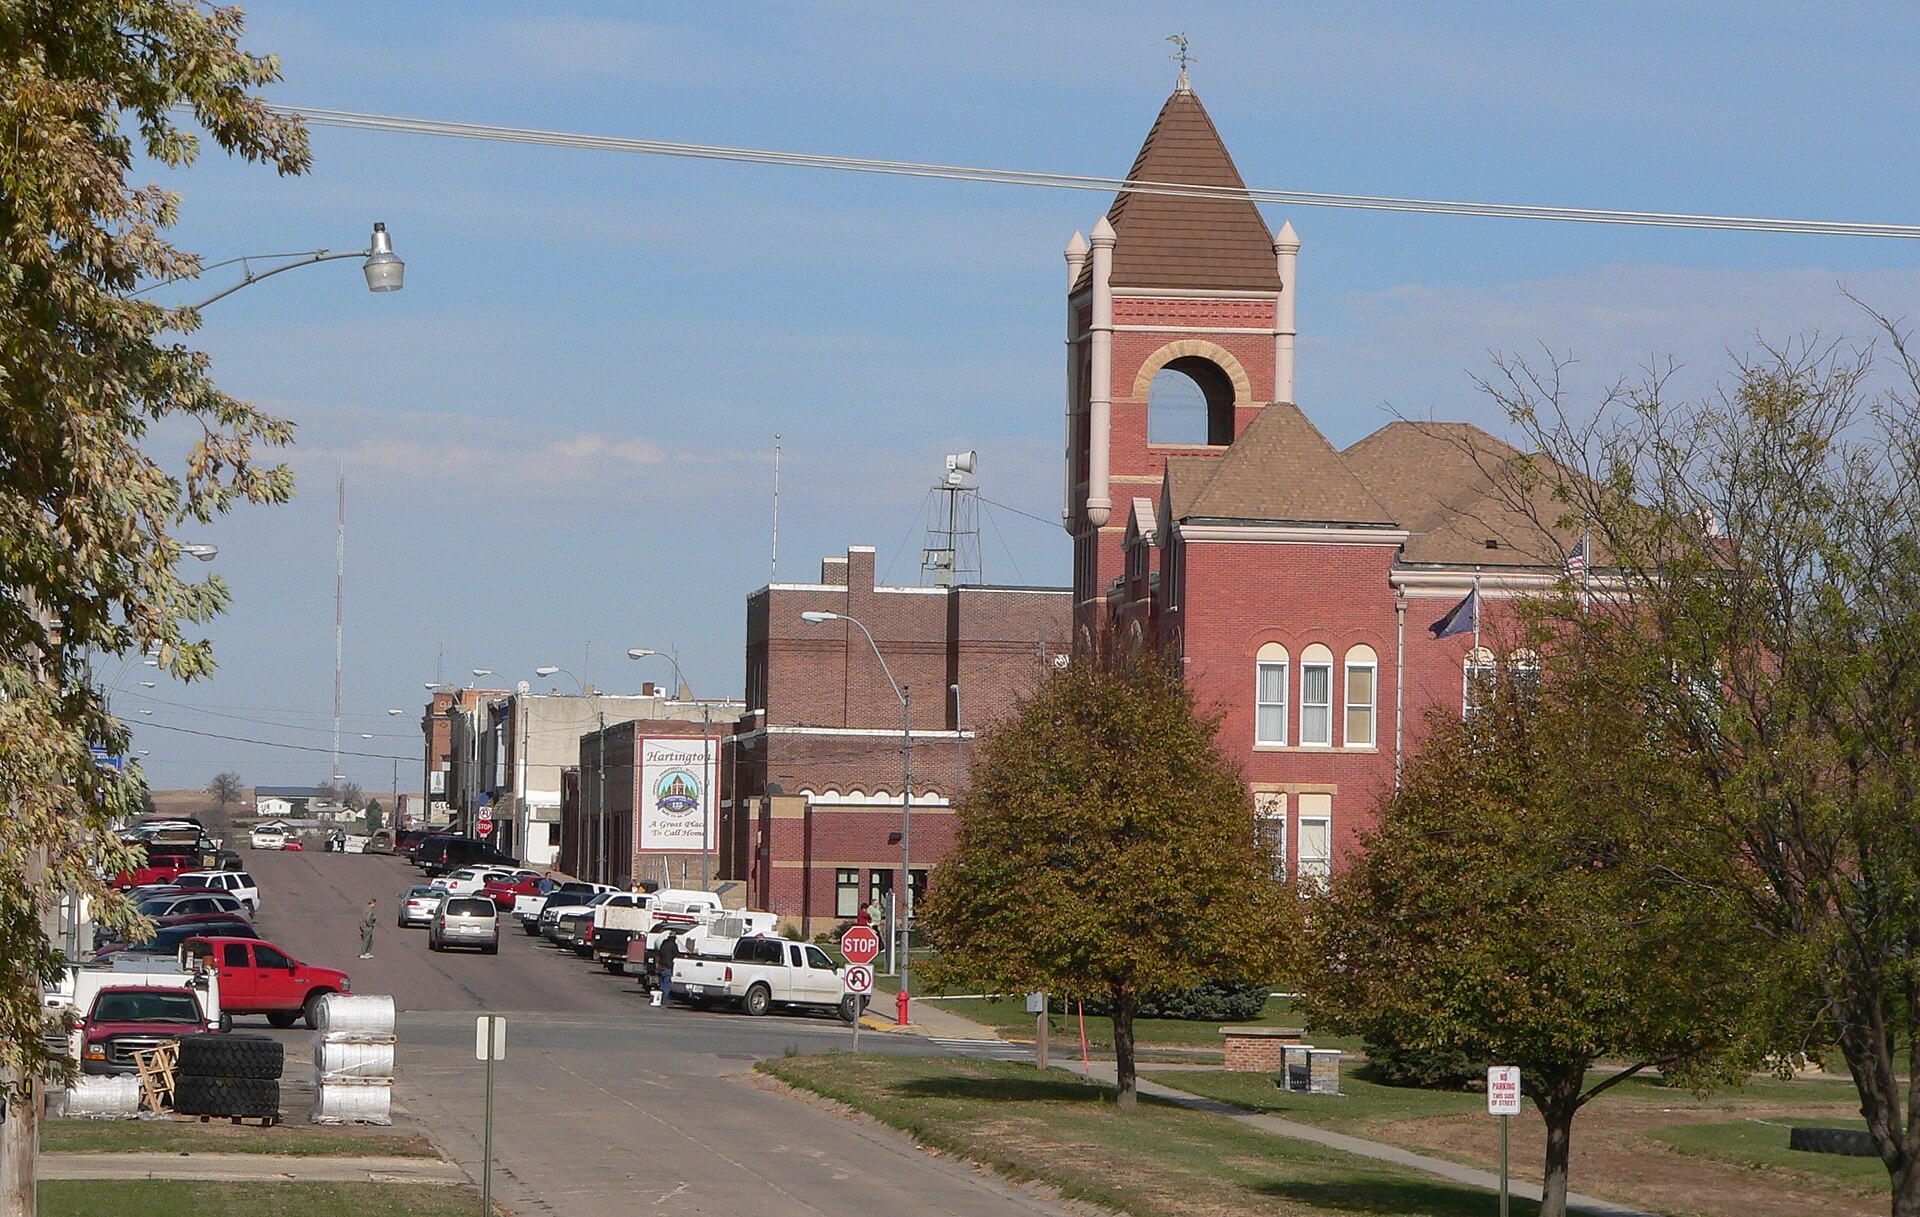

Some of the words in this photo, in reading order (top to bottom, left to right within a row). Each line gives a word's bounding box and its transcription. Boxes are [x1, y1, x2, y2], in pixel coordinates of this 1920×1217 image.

[646, 751, 711, 765] Hartington
[660, 821, 682, 829] Great
[844, 938, 876, 953] STOP
[1500, 1073, 1508, 1081] NO
